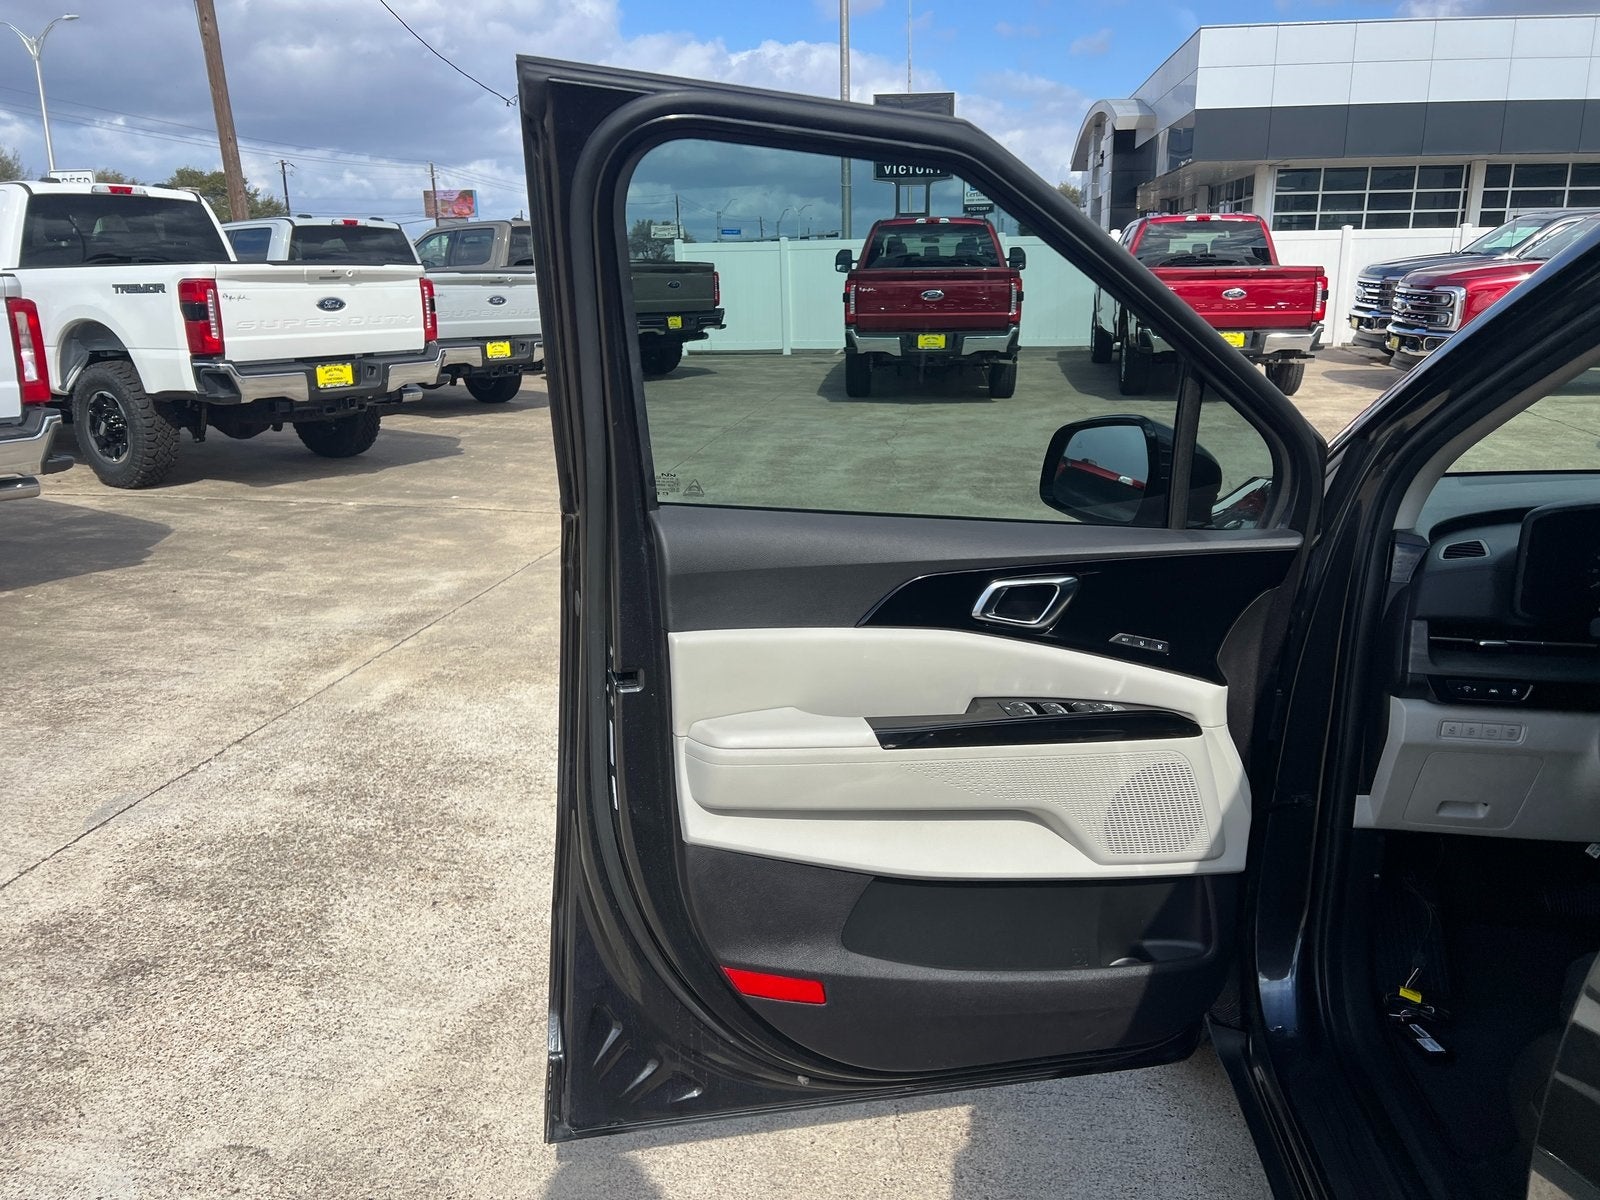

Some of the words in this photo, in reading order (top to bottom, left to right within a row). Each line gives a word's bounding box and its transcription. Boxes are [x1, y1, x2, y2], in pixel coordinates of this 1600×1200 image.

[112, 283, 166, 294] TREMOR
[236, 317, 342, 331] SUPER
[348, 313, 416, 327] DUTY
